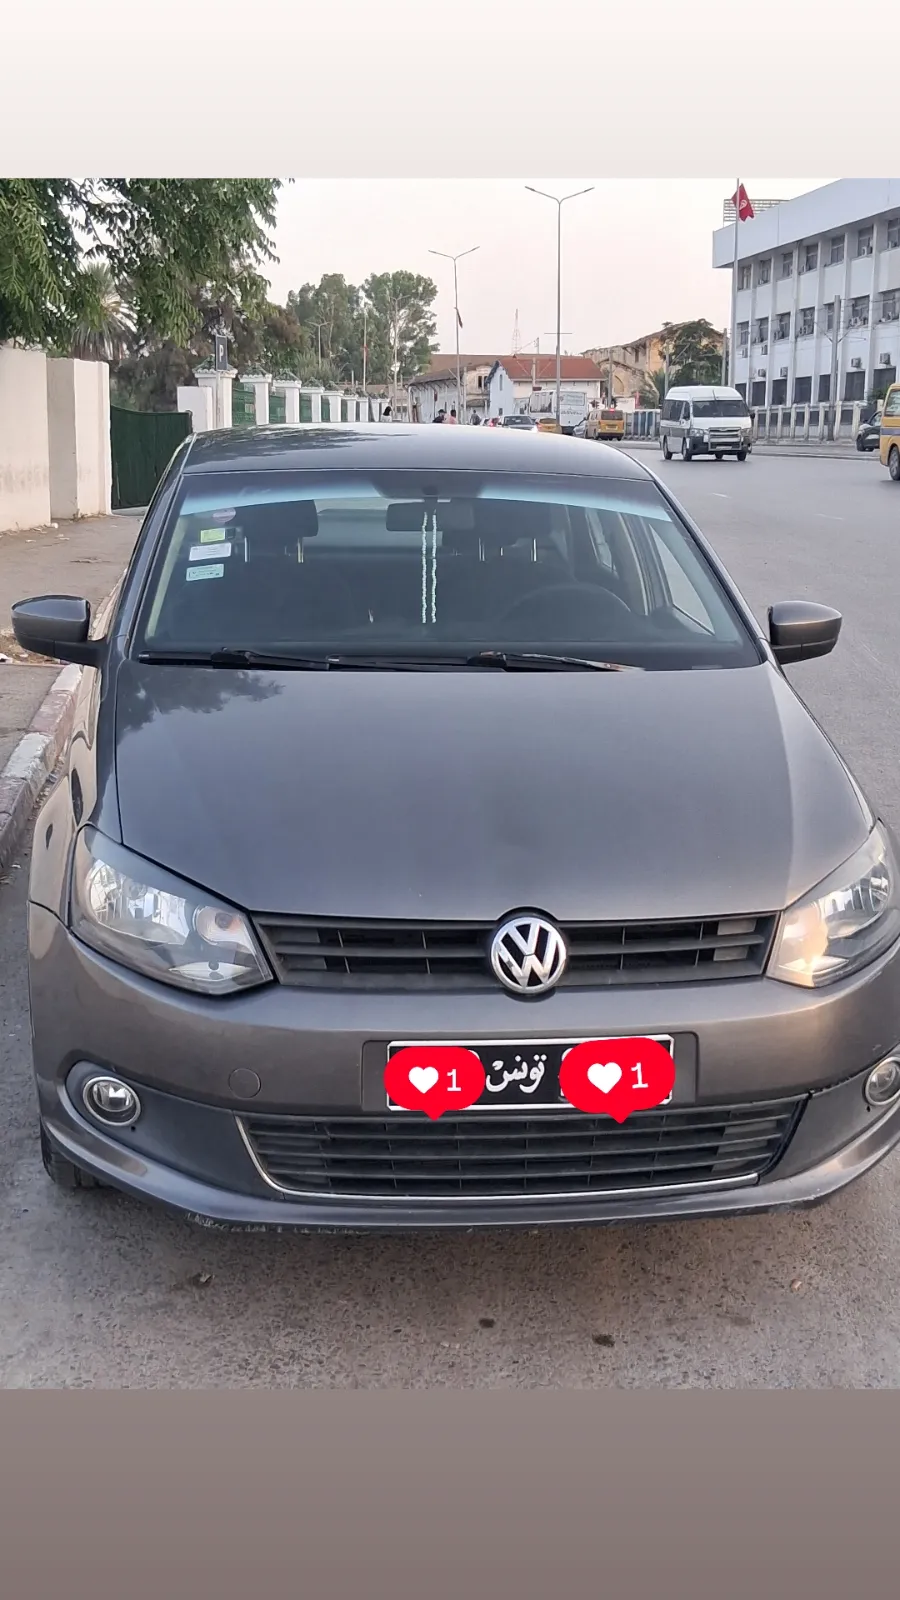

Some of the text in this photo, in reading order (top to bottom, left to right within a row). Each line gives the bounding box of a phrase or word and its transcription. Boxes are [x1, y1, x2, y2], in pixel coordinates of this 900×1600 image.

[219, 344, 224, 362] P
[491, 917, 566, 994] VW
[485, 1054, 547, 1093] تونس
